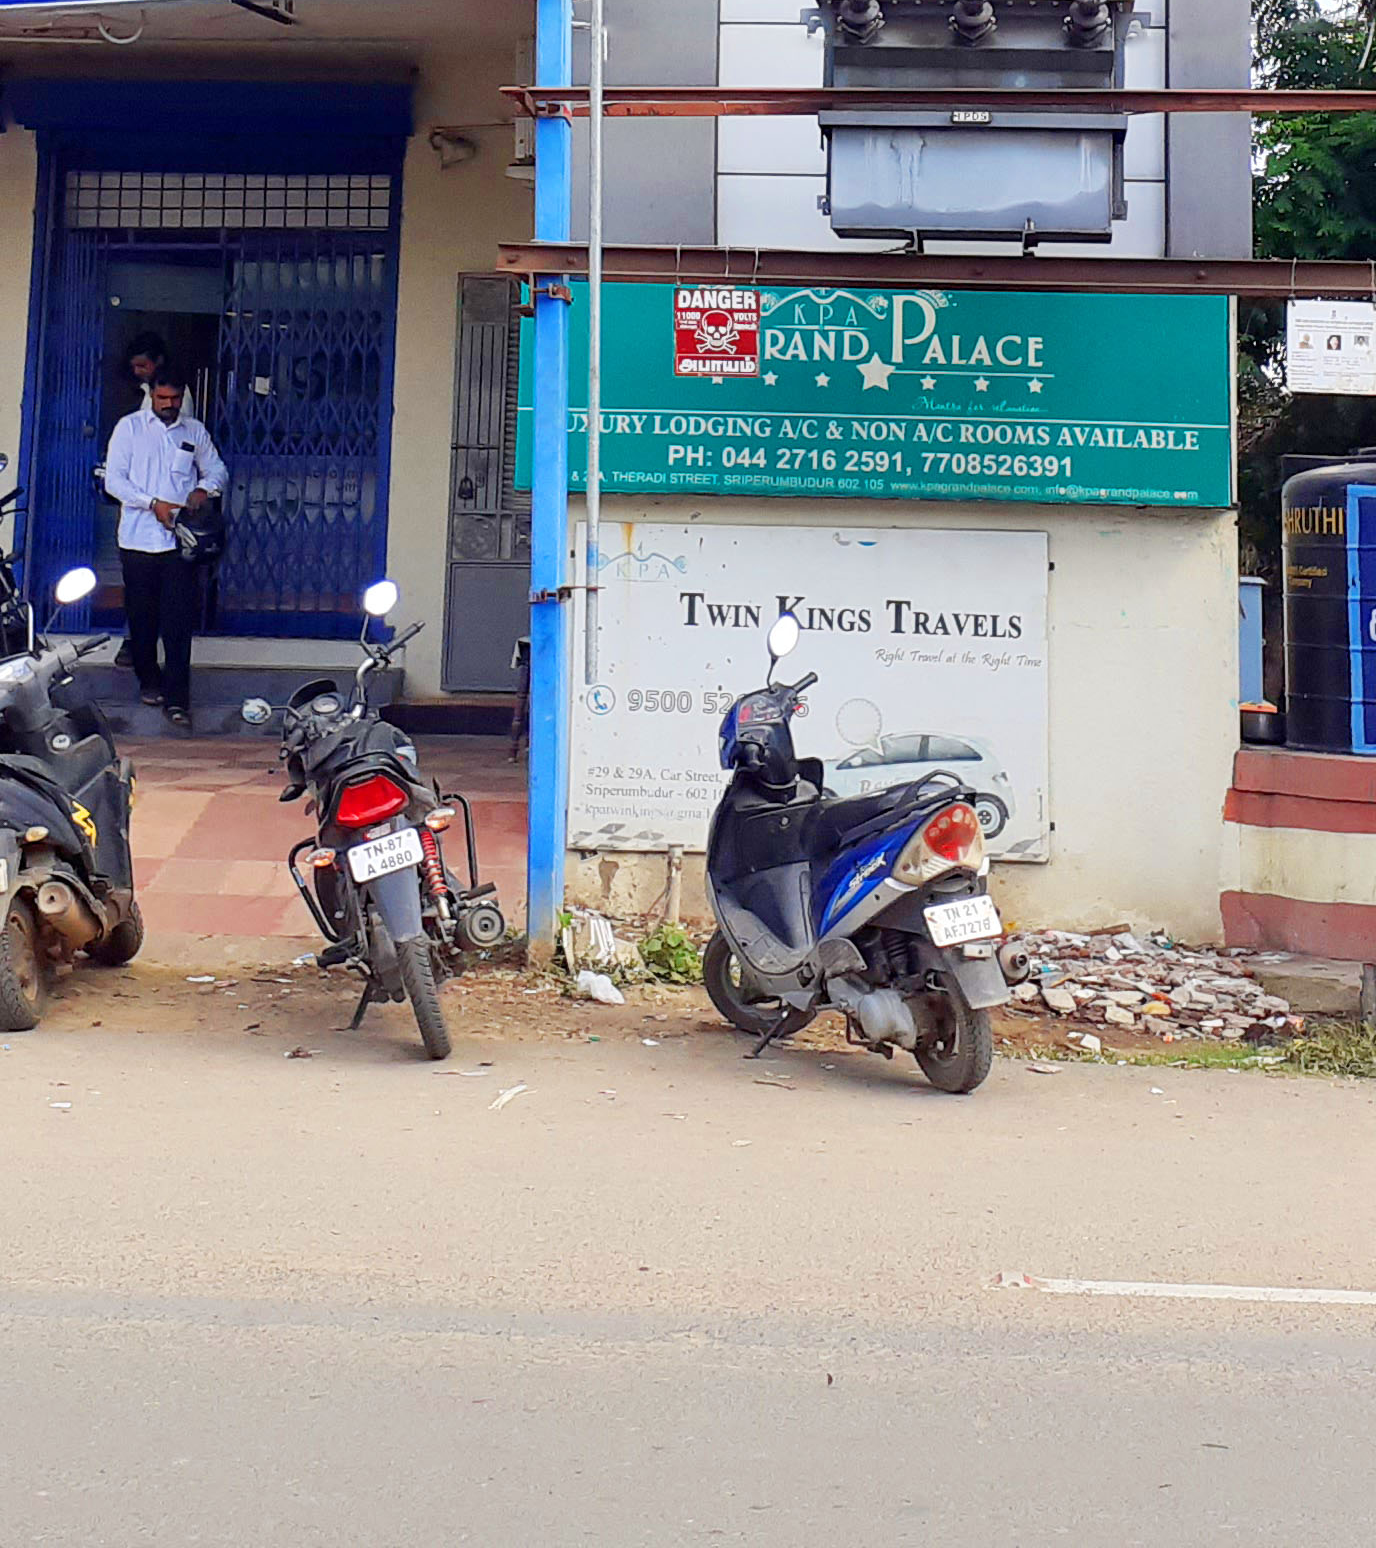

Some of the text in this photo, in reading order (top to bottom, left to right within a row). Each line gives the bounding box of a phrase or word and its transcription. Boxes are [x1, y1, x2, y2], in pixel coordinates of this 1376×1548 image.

[677, 290, 757, 309] DANGER
[734, 312, 757, 322] VOLTS
[794, 303, 859, 326] KPA
[763, 294, 1044, 368] RAND PALACE
[652, 414, 772, 438] LODGING
[779, 417, 819, 440] A/C
[825, 420, 843, 440] &
[850, 420, 907, 443] NON
[913, 422, 954, 445] A/C
[959, 423, 1051, 447] ROOMS
[1056, 427, 1201, 451] AVAILABLE
[667, 443, 1073, 479] PH: 044 2716 2591, 7708526391
[612, 471, 667, 484] THERADI
[723, 474, 835, 490] SRIPERUMBUDUR
[837, 477, 860, 490] 602
[864, 478, 885, 491] 105
[679, 591, 762, 629] TWIN
[885, 599, 1023, 641] TRAVELS
[875, 647, 905, 668] Right
[910, 648, 943, 664] Travel
[981, 651, 1012, 672] Right
[1016, 654, 1043, 668] Time
[627, 689, 693, 715] 9500
[661, 768, 683, 782] Car
[686, 787, 708, 800] 602
[367, 850, 413, 876] A 4880
[942, 903, 979, 921] TN 21
